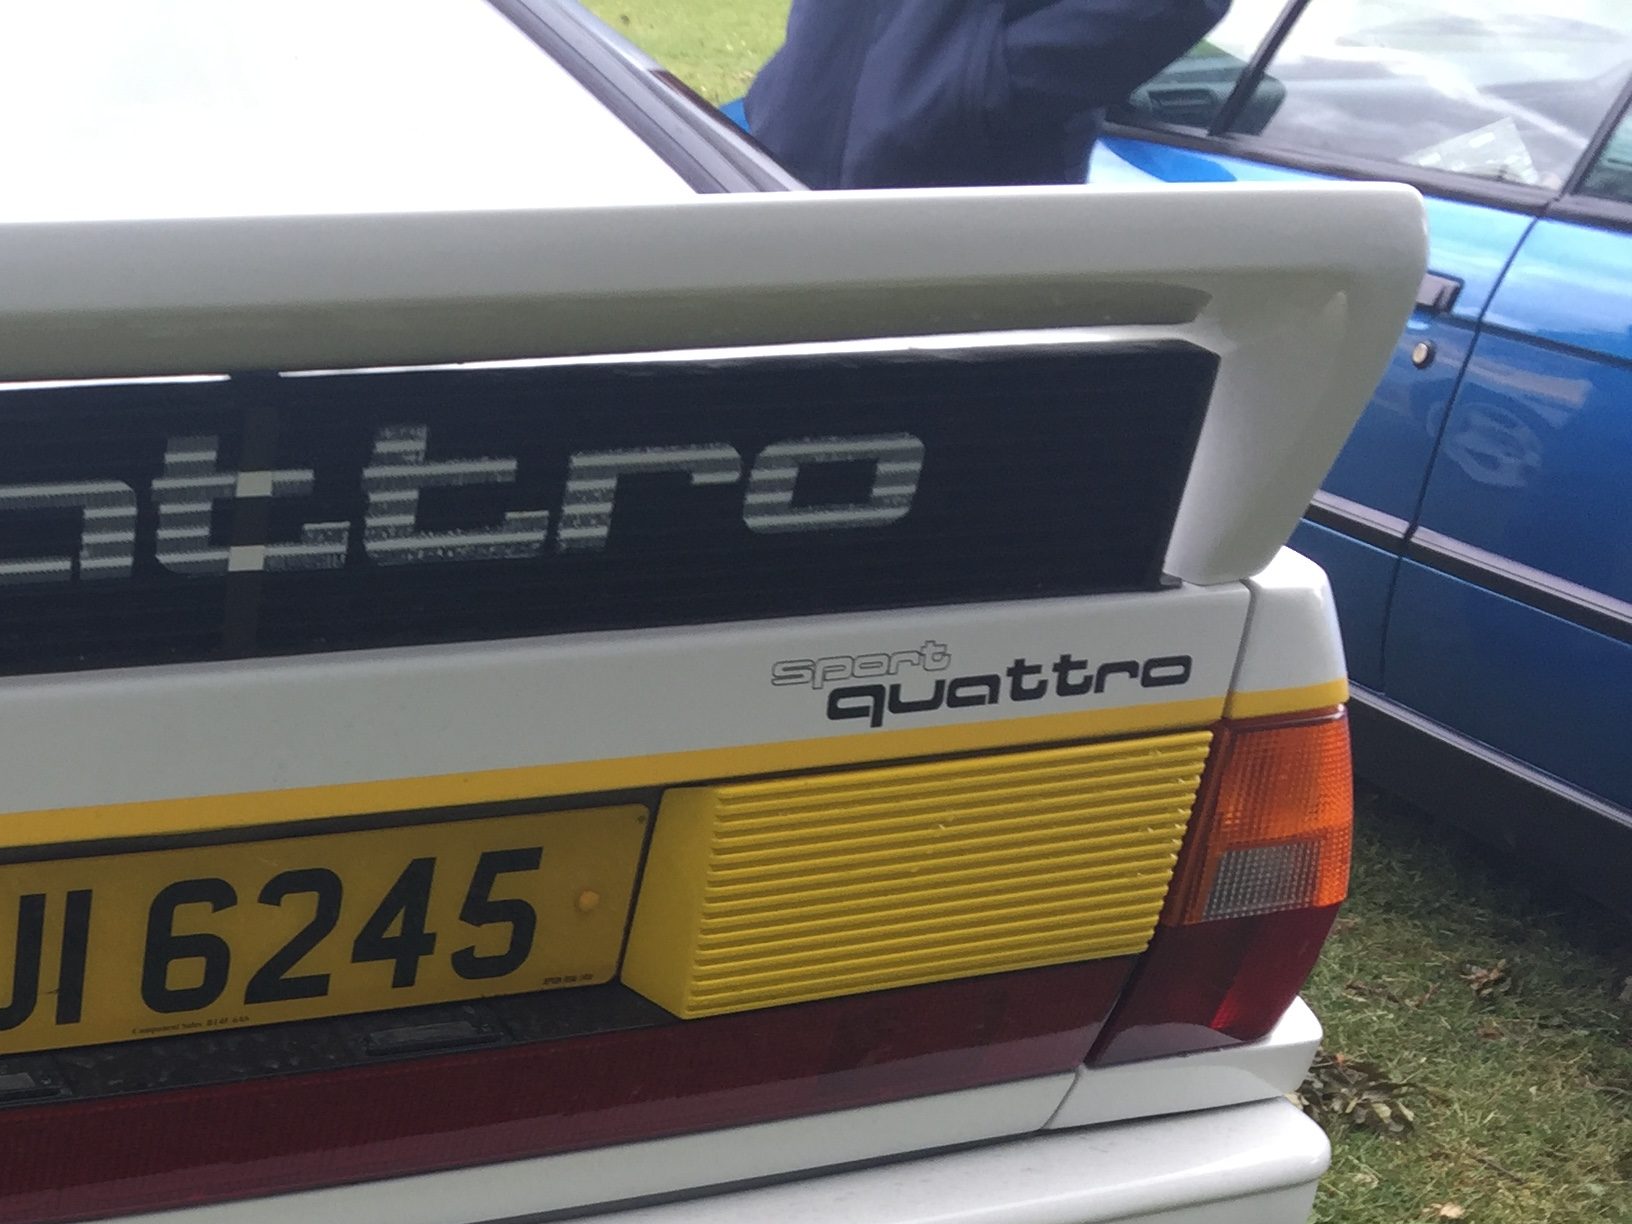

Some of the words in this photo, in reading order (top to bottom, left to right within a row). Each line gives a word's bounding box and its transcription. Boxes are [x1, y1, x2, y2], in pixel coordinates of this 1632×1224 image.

[771, 640, 951, 690] sport
[826, 654, 1193, 728] quattro
[139, 846, 544, 1013] 6245
